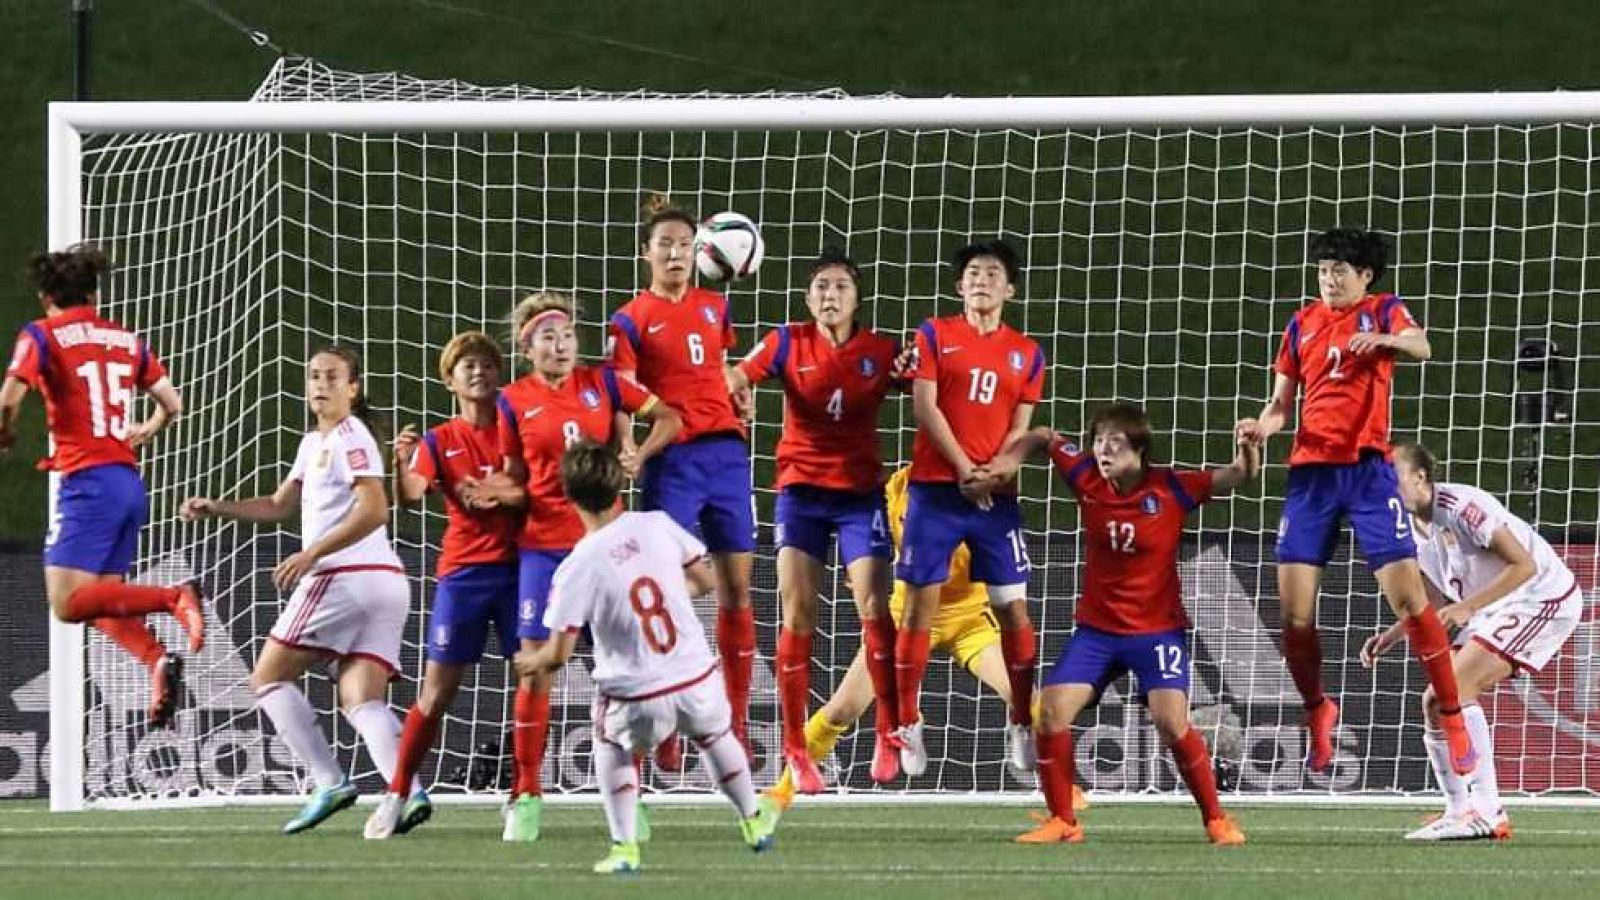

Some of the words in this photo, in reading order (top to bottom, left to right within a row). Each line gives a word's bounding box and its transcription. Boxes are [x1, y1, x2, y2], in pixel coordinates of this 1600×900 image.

[688, 334, 705, 365] 6
[1328, 346, 1345, 379] 2
[76, 361, 133, 440] 15
[969, 367, 998, 405] 19
[827, 388, 843, 421] 4
[872, 509, 886, 537] 4
[1388, 498, 1408, 529] 2
[1107, 520, 1136, 552] 12
[630, 575, 678, 655] 8
[1492, 615, 1520, 642] 2
[1154, 644, 1183, 675] 12
